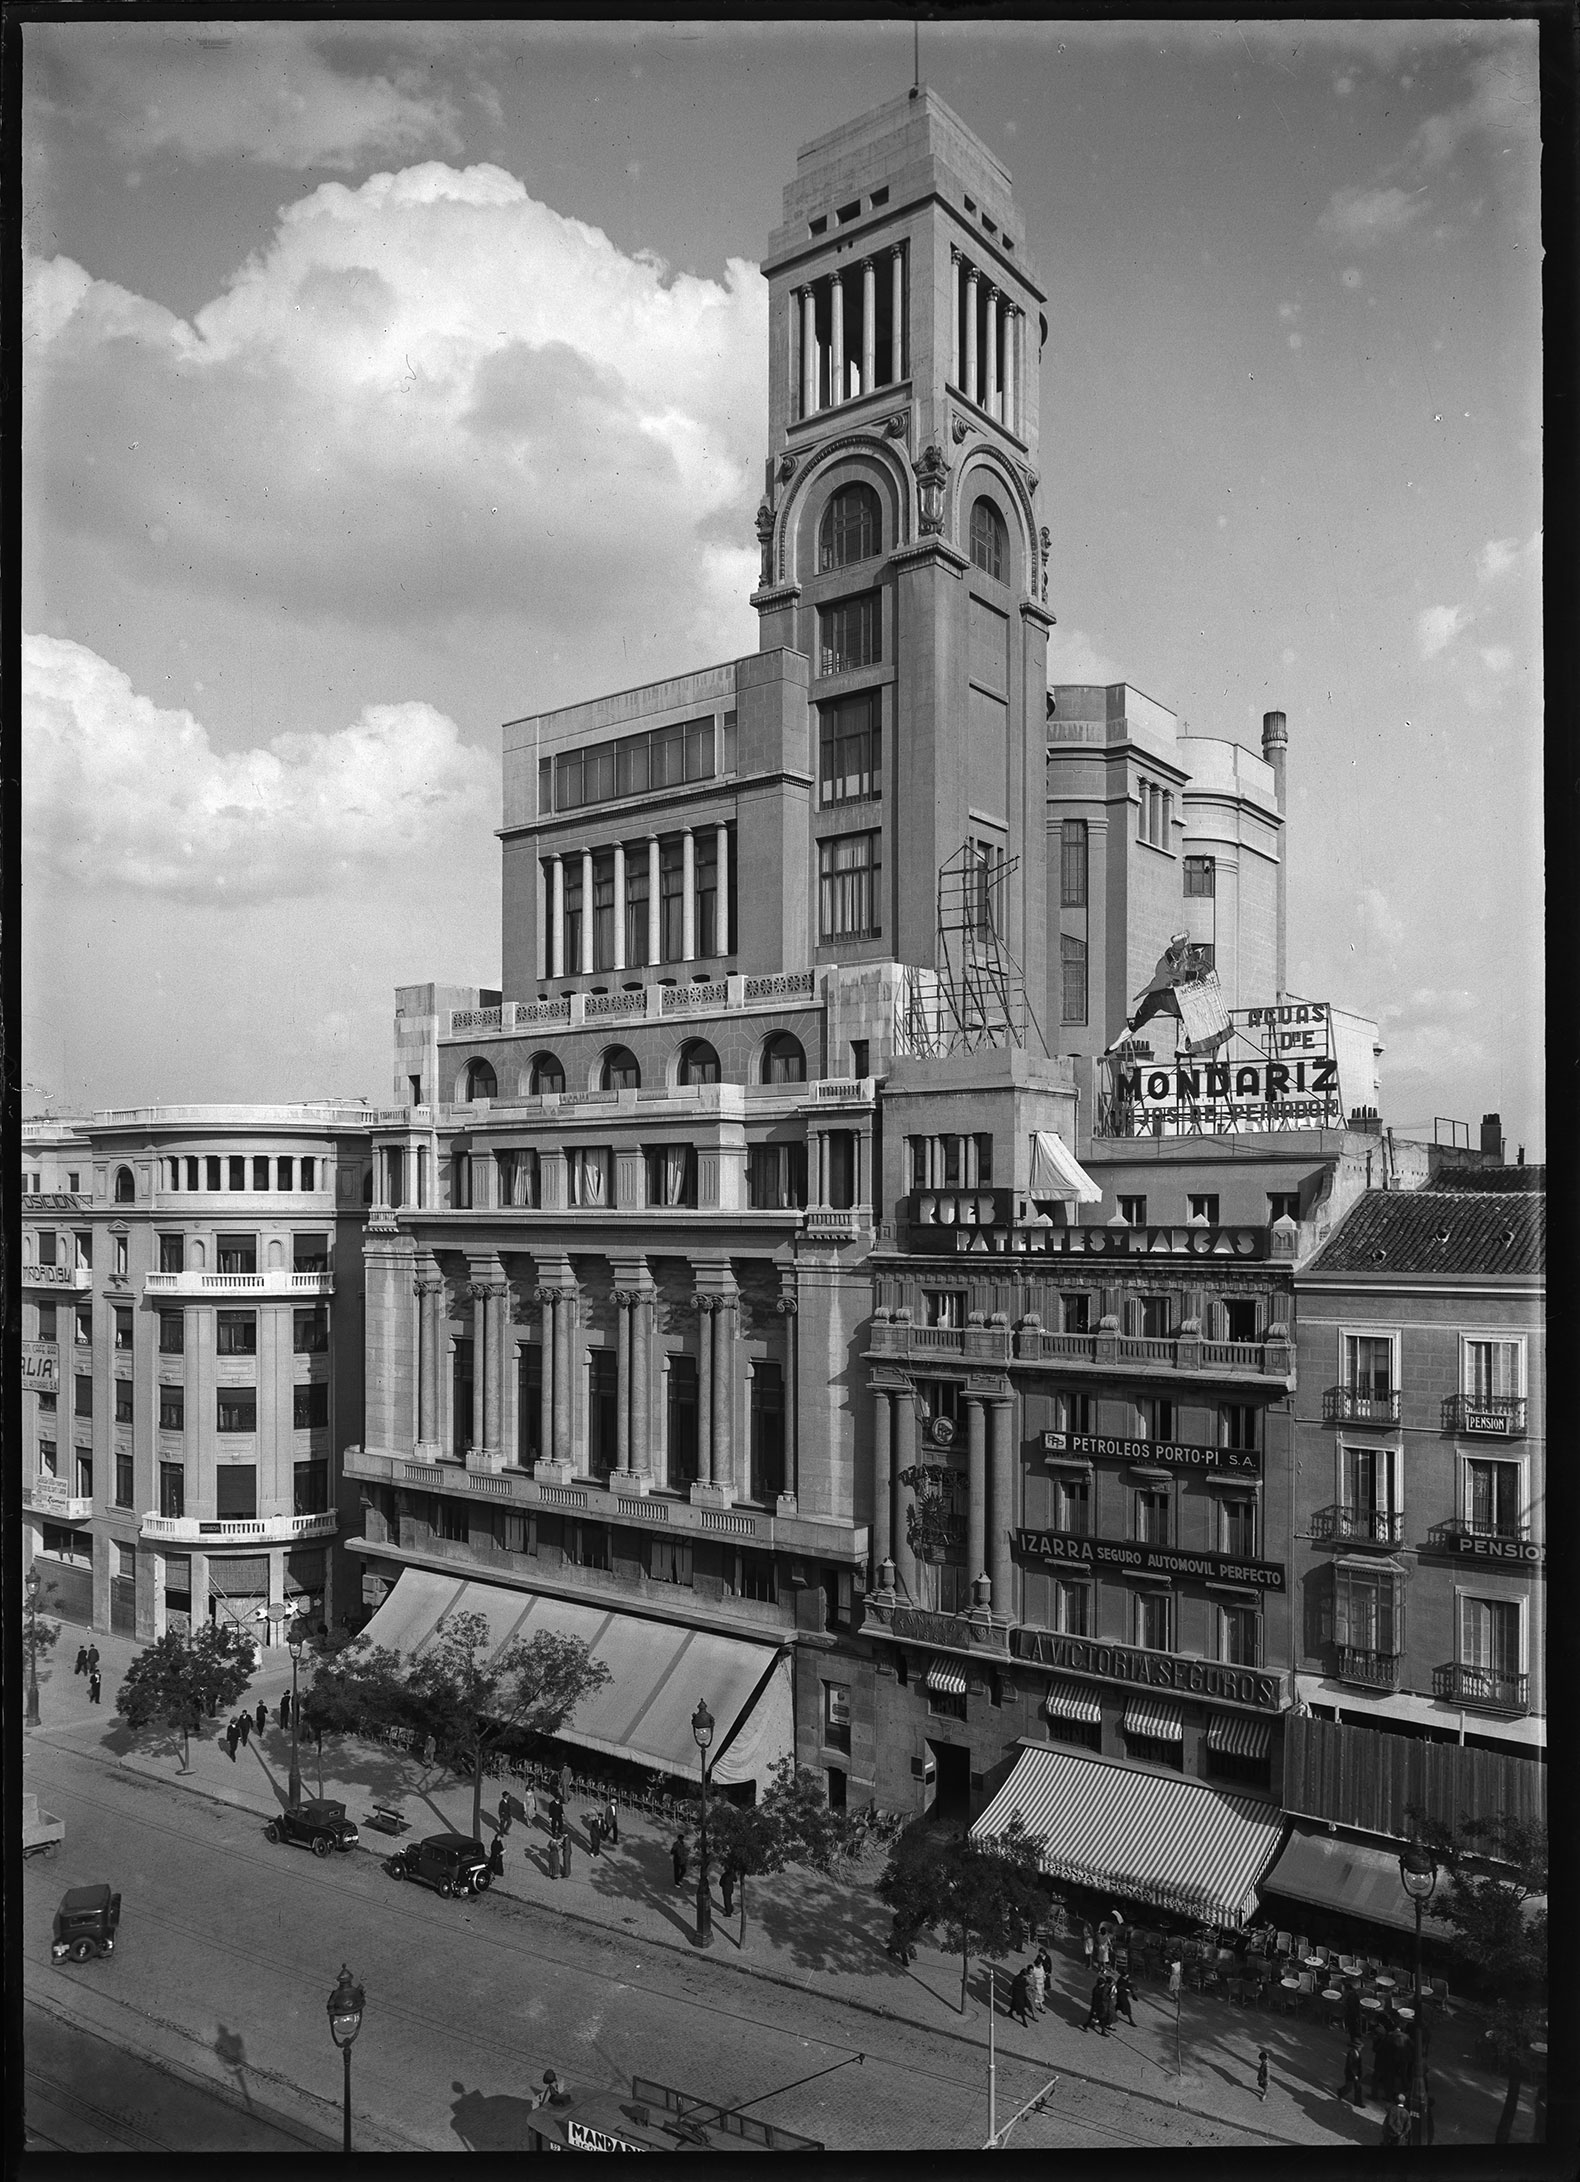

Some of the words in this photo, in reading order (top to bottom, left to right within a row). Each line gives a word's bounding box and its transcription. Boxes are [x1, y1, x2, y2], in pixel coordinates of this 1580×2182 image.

[1249, 1004, 1325, 1028] AGUAS
[1281, 1031, 1315, 1050] DE
[1118, 1060, 1338, 1102] MONDARIZ
[1112, 1106, 1180, 1126] HIJOS
[1190, 1105, 1217, 1123] DE
[1233, 1100, 1338, 1122] PEINADOR
[22, 1194, 78, 1209] OSICION
[956, 1229, 1106, 1252] PATENTES
[1111, 1234, 1124, 1246] Y
[1128, 1229, 1255, 1254] MARCAS
[1469, 1415, 1506, 1431] PENSION
[1229, 1454, 1256, 1467] S.A.
[1021, 1533, 1094, 1560] IZARRA
[1097, 1547, 1142, 1565] SEGURO
[1147, 1553, 1216, 1576] AUTOMOVIL
[1220, 1564, 1282, 1586] PERFECTO
[1019, 1631, 1044, 1661] LA
[1158, 1659, 1275, 1705] SEGUROS
[1046, 1862, 1095, 1883] GRANJA
